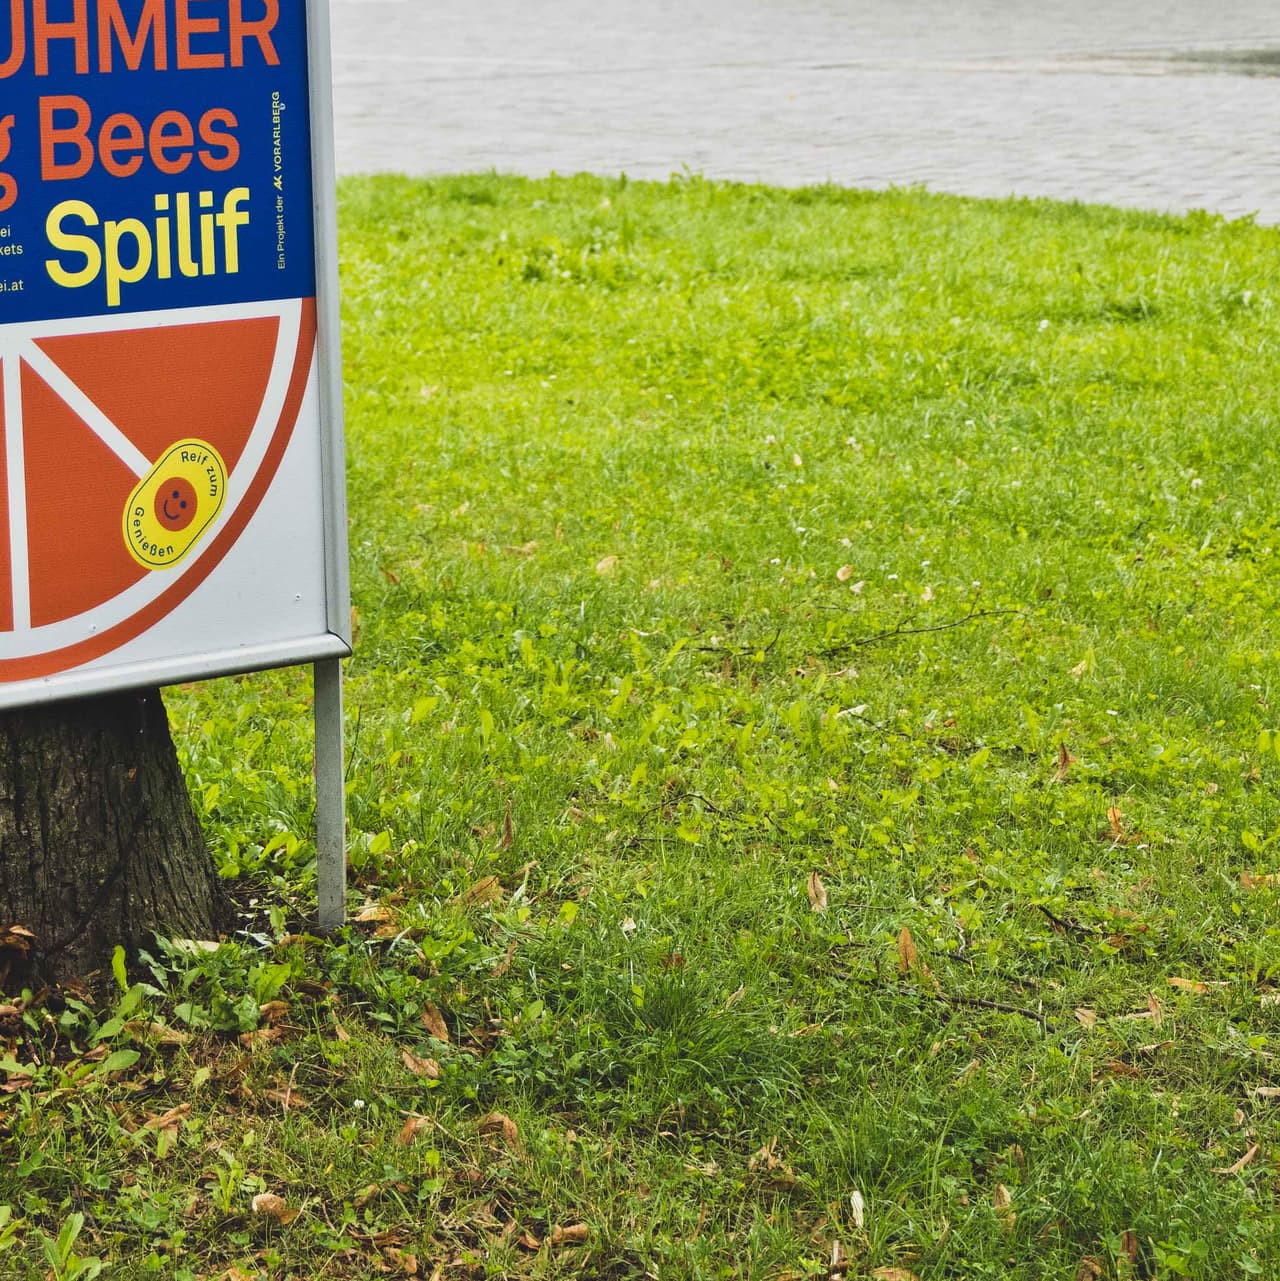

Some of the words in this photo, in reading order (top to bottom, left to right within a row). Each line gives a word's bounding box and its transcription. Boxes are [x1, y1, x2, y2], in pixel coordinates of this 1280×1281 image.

[38, 94, 240, 182] Bees
[271, 91, 283, 172] VORARLBERG
[276, 195, 284, 212] der
[45, 187, 250, 306] Spilif
[276, 213, 287, 252] Projekt
[277, 253, 286, 270] Ein
[180, 450, 209, 466] Reif
[206, 465, 218, 497] zum
[133, 506, 174, 557] Genießen
